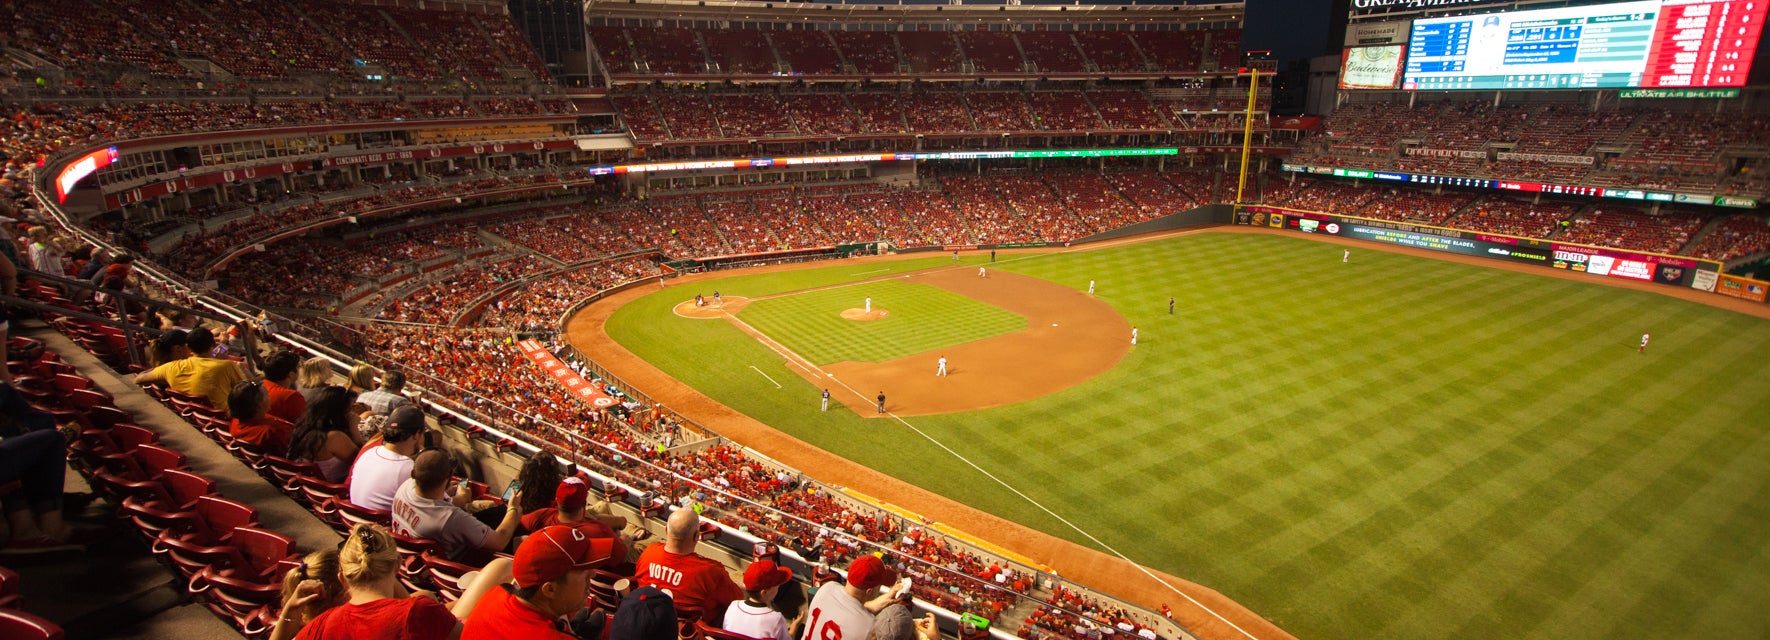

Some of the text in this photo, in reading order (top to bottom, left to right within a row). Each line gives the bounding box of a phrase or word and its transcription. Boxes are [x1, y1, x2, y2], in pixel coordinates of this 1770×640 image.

[336, 155, 368, 166] CINCINNATI
[1726, 198, 1752, 206] Evans
[1354, 227, 1386, 236] LUBRICATION
[1511, 252, 1546, 260] #PROSHIELD
[572, 528, 584, 542] C
[649, 562, 683, 586] VOTTO
